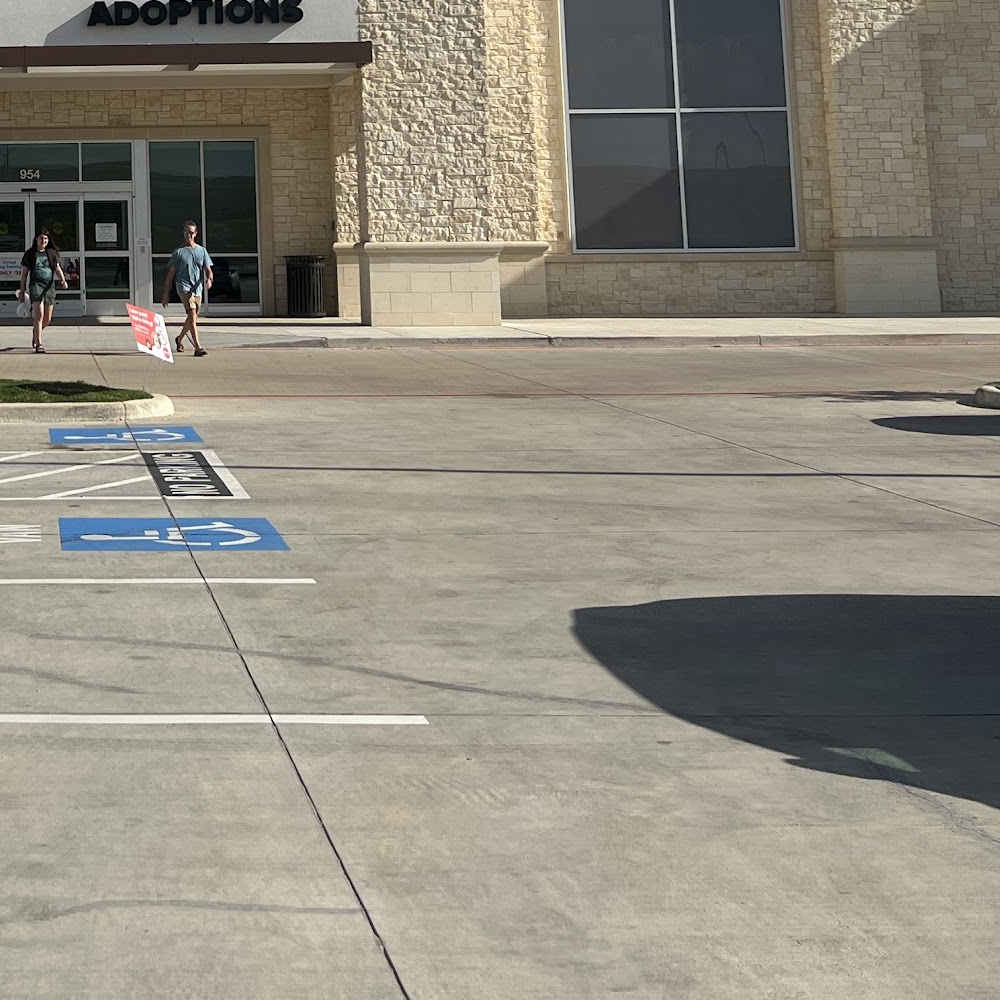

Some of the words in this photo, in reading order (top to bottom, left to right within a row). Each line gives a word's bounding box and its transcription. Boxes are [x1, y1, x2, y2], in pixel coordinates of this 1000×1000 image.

[19, 168, 41, 180] 954
[152, 453, 212, 482] PARKING
[168, 484, 221, 495] NO
